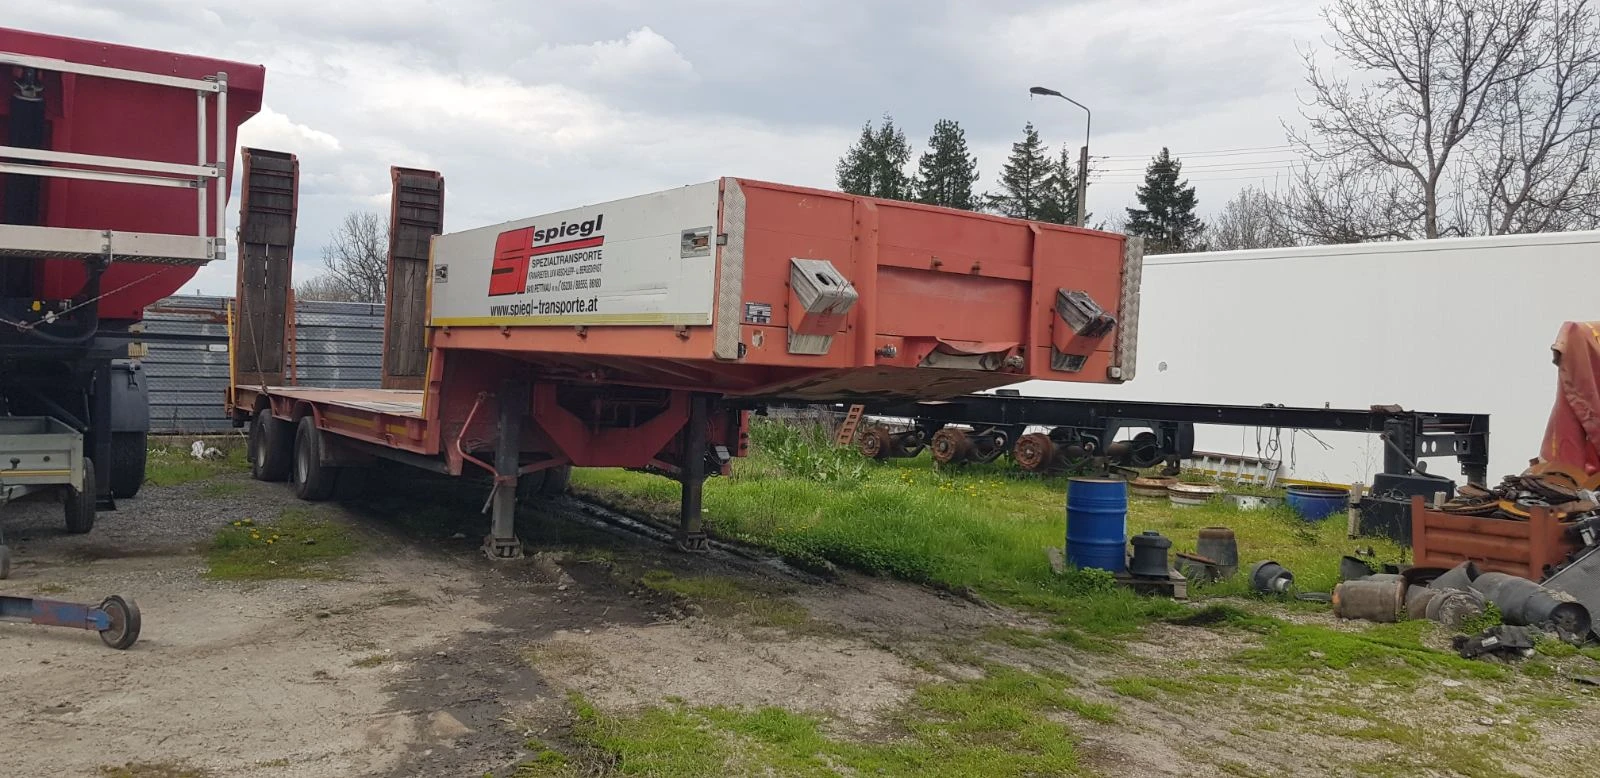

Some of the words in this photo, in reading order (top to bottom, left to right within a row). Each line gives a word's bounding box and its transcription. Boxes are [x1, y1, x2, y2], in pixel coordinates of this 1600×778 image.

[534, 214, 604, 243] spiegl
[531, 249, 603, 269] SPEZIALTRANSPORTE
[490, 295, 599, 317] www.spiegl-transporte.at
